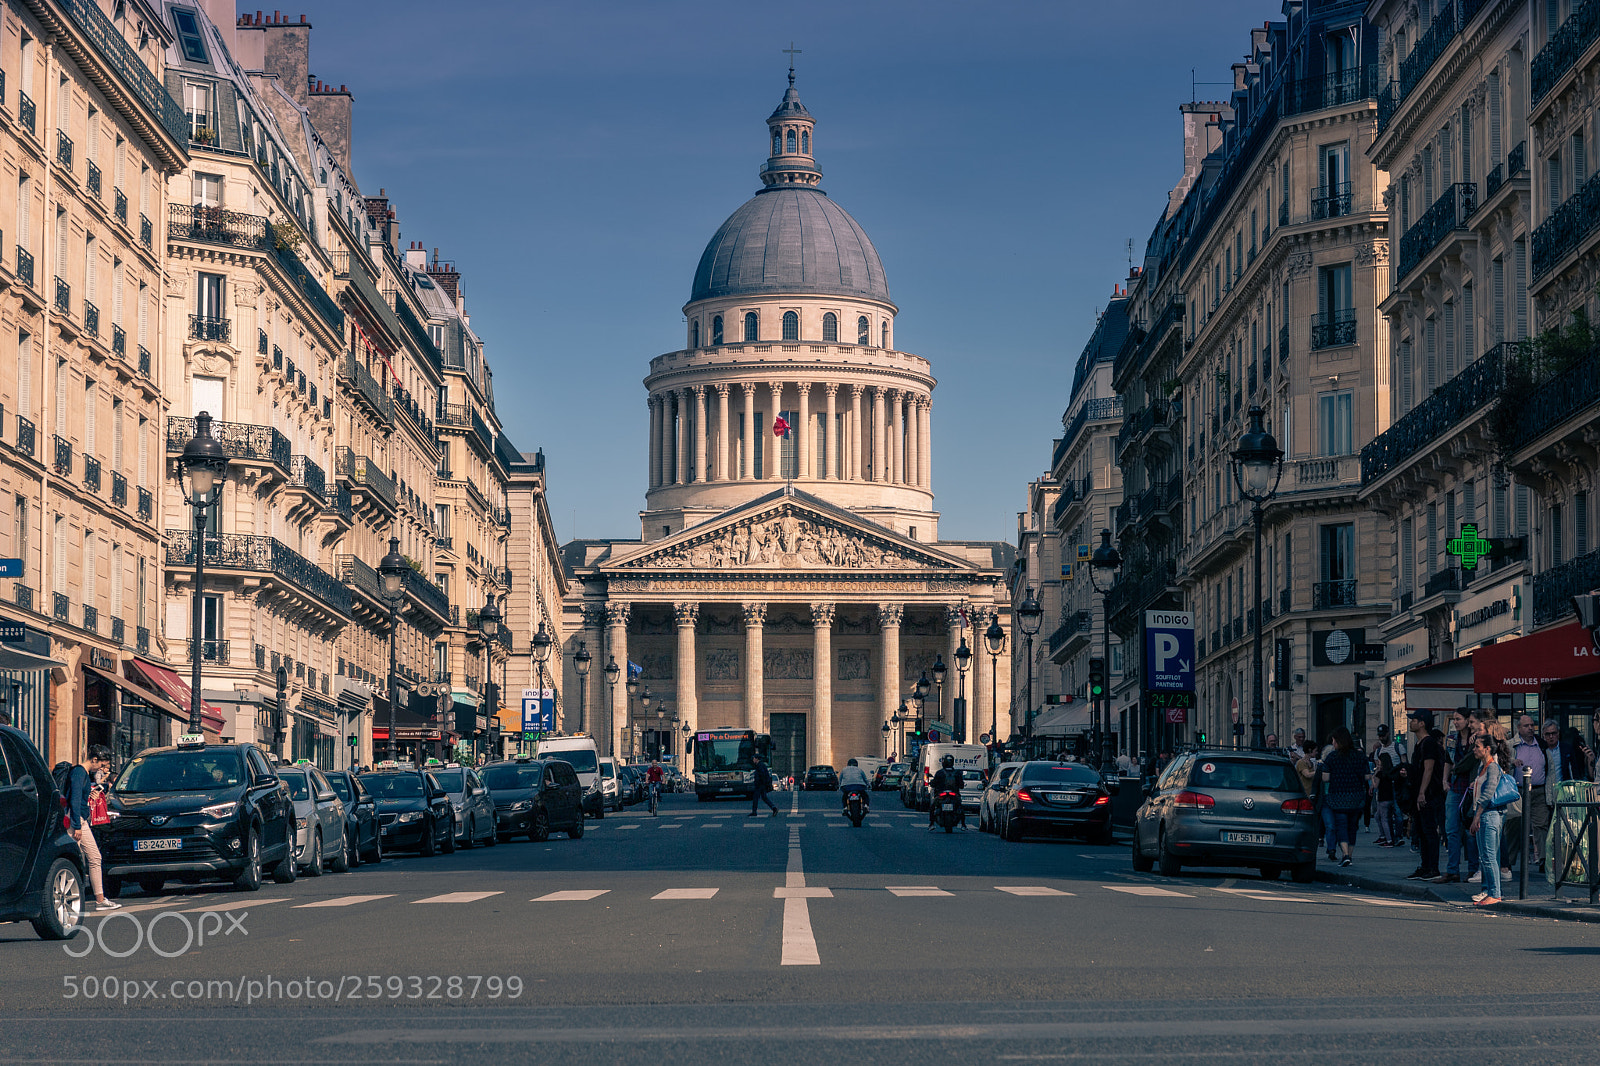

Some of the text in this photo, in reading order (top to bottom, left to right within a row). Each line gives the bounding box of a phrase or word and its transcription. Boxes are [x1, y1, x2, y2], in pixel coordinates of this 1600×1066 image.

[652, 581, 923, 591] AUX GRANDS HOMMES LA PATRIE RECONNAISSANTE
[1153, 614, 1189, 625] INDIGO
[1154, 632, 1180, 672] P
[1573, 646, 1589, 657] LA
[1502, 677, 1538, 685] MOULES
[1151, 693, 1165, 707] 24
[1176, 694, 1189, 707] 24
[525, 699, 540, 722] P
[525, 732, 534, 740] 24
[1204, 763, 1212, 772] A
[138, 839, 177, 850] ES-242-VR
